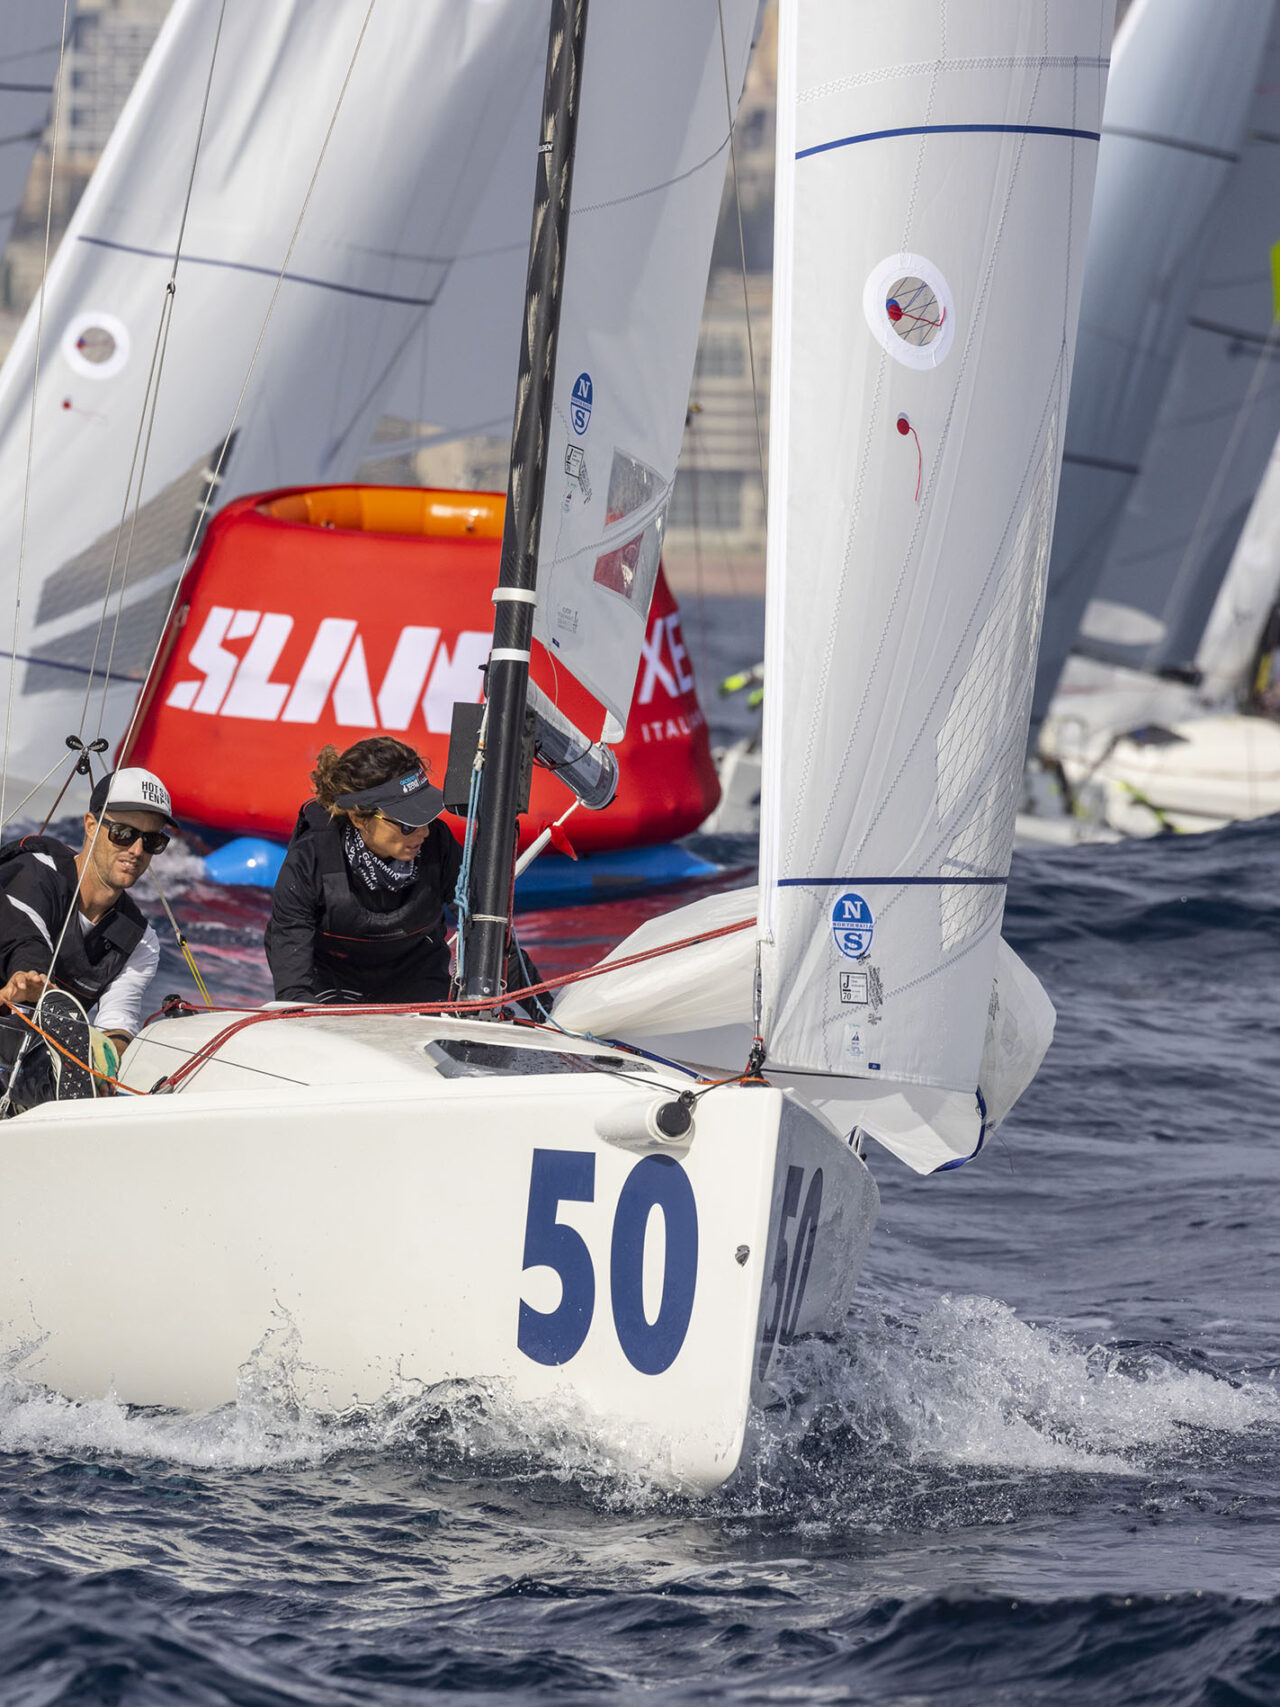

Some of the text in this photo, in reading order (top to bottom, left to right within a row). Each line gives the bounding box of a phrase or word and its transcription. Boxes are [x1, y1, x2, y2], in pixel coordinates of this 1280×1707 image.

[578, 379, 591, 398] N
[575, 409, 585, 429] S
[842, 900, 863, 920] N
[843, 932, 863, 951] S
[842, 975, 850, 989] J
[842, 992, 852, 1001] 70
[516, 1147, 699, 1376] 50
[757, 1164, 823, 1384] 50
